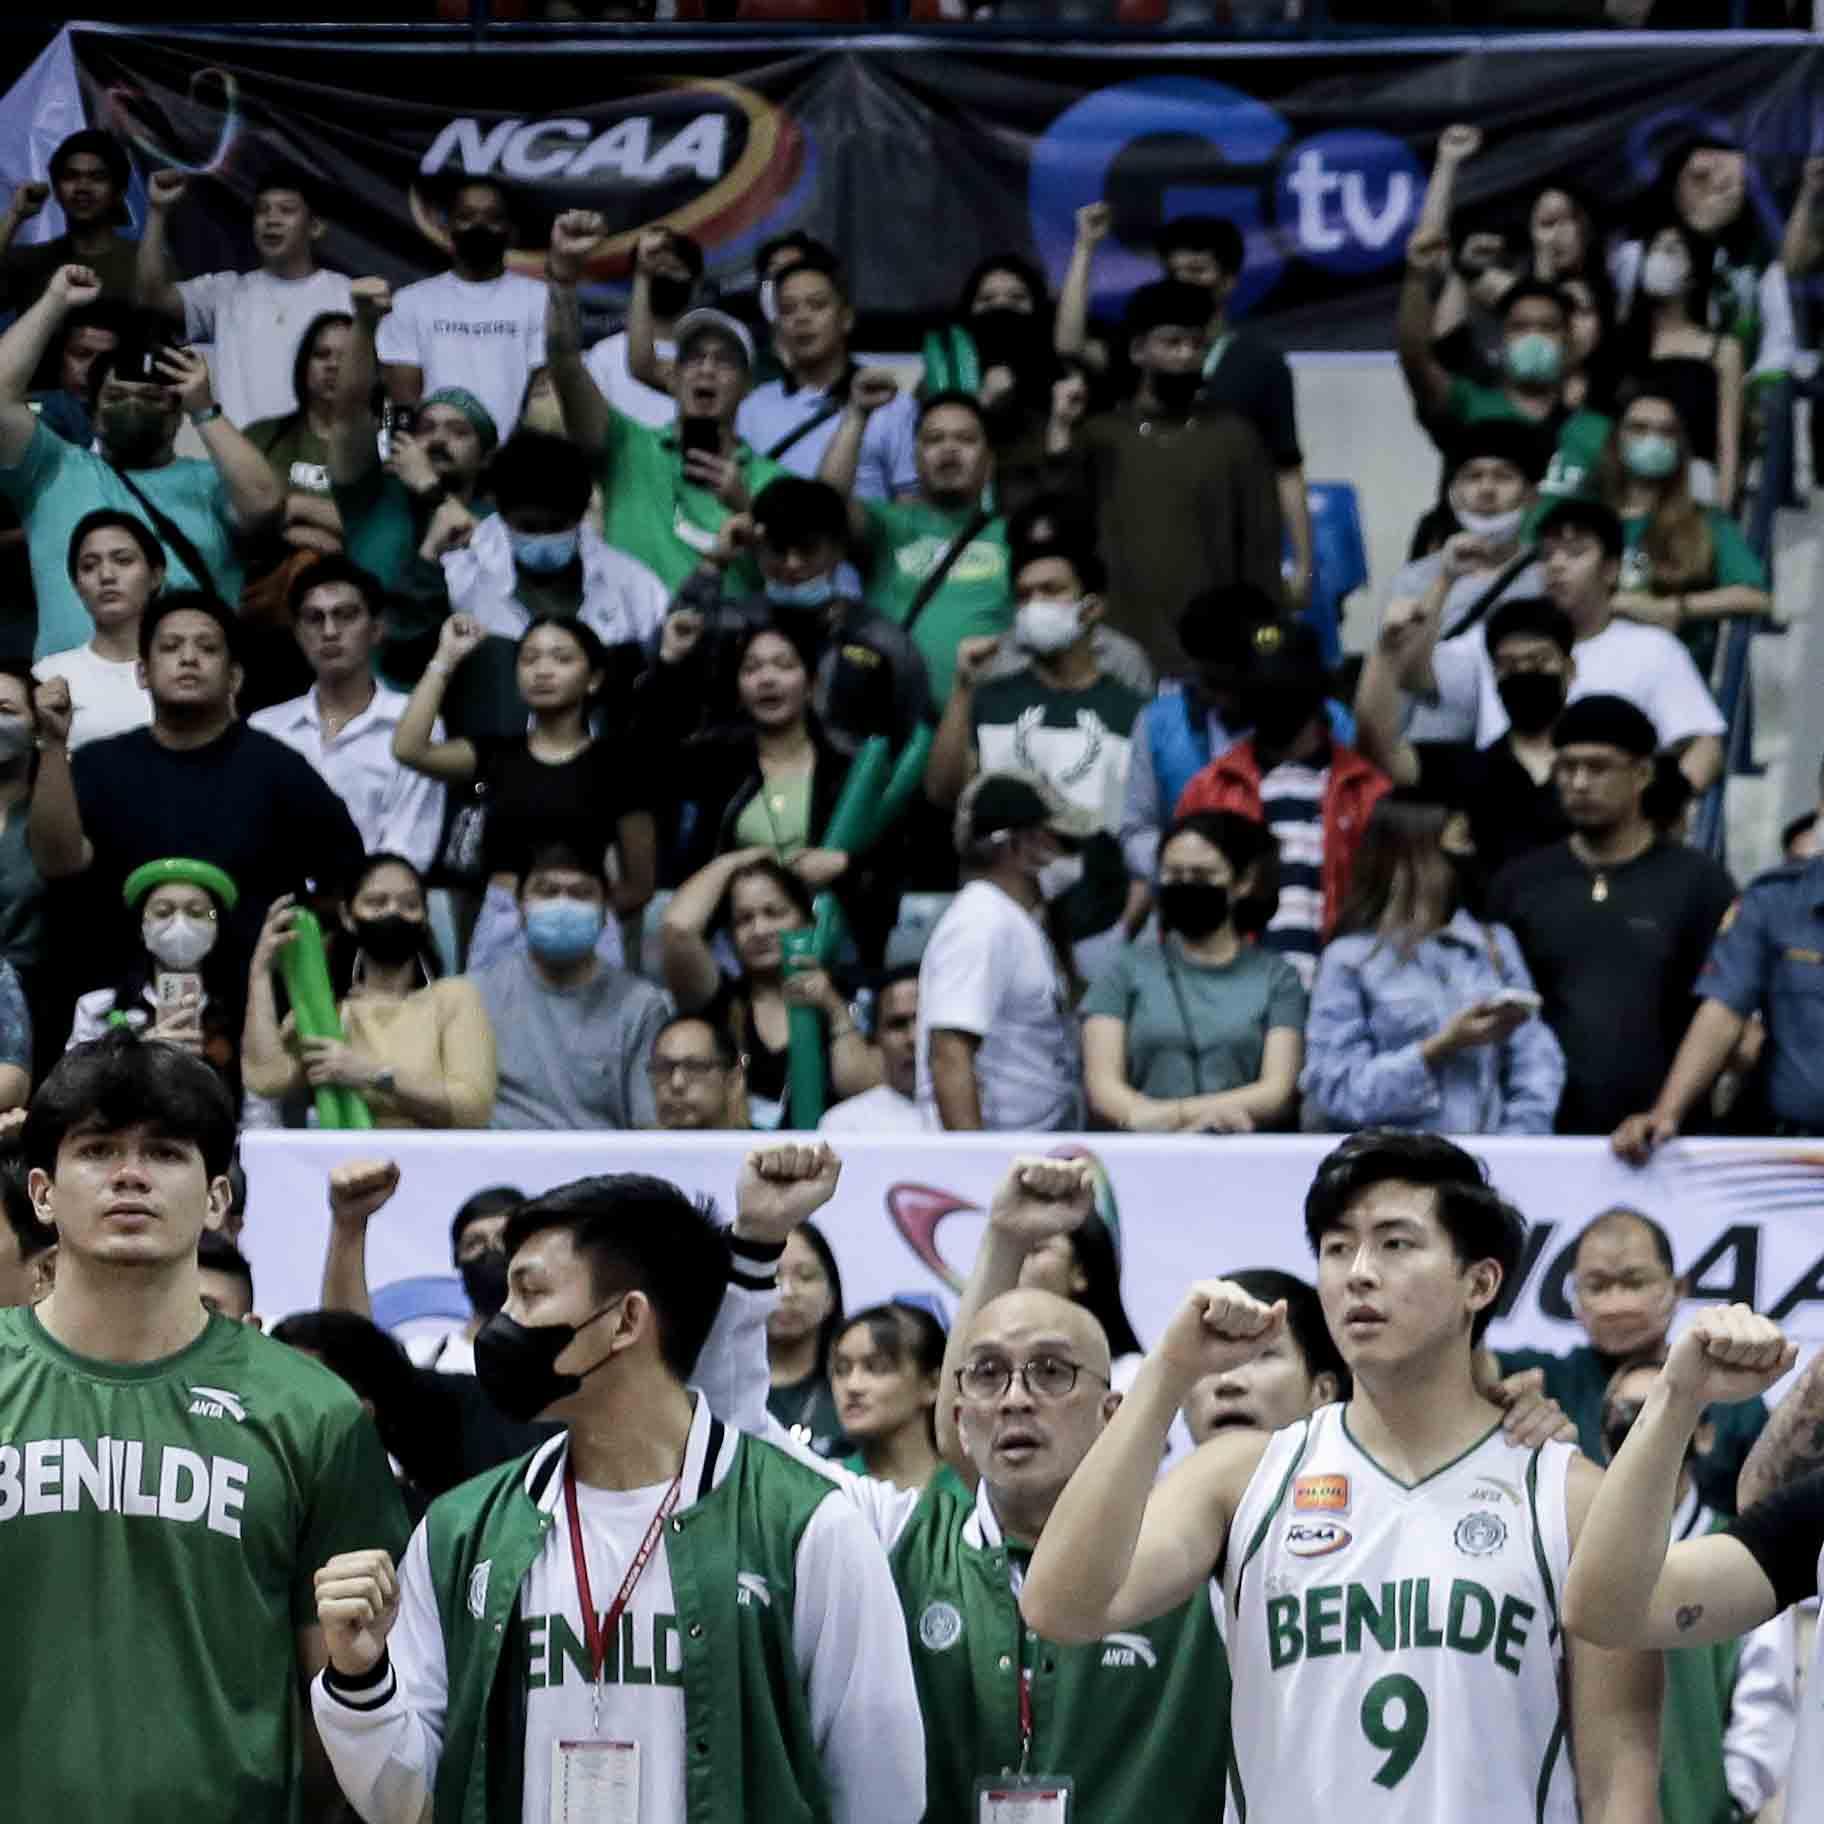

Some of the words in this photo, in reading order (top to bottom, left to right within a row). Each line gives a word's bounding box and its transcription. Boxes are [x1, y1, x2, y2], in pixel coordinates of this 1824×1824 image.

[420, 113, 729, 180] NCAA
[1288, 150, 1414, 252] tv
[187, 1400, 226, 1419] ANTA
[522, 1612, 684, 1689] ENILD
[1102, 1648, 1136, 1667] ANTA
[1266, 1576, 1535, 1675] BENILDE
[1360, 1673, 1430, 1790] 9
